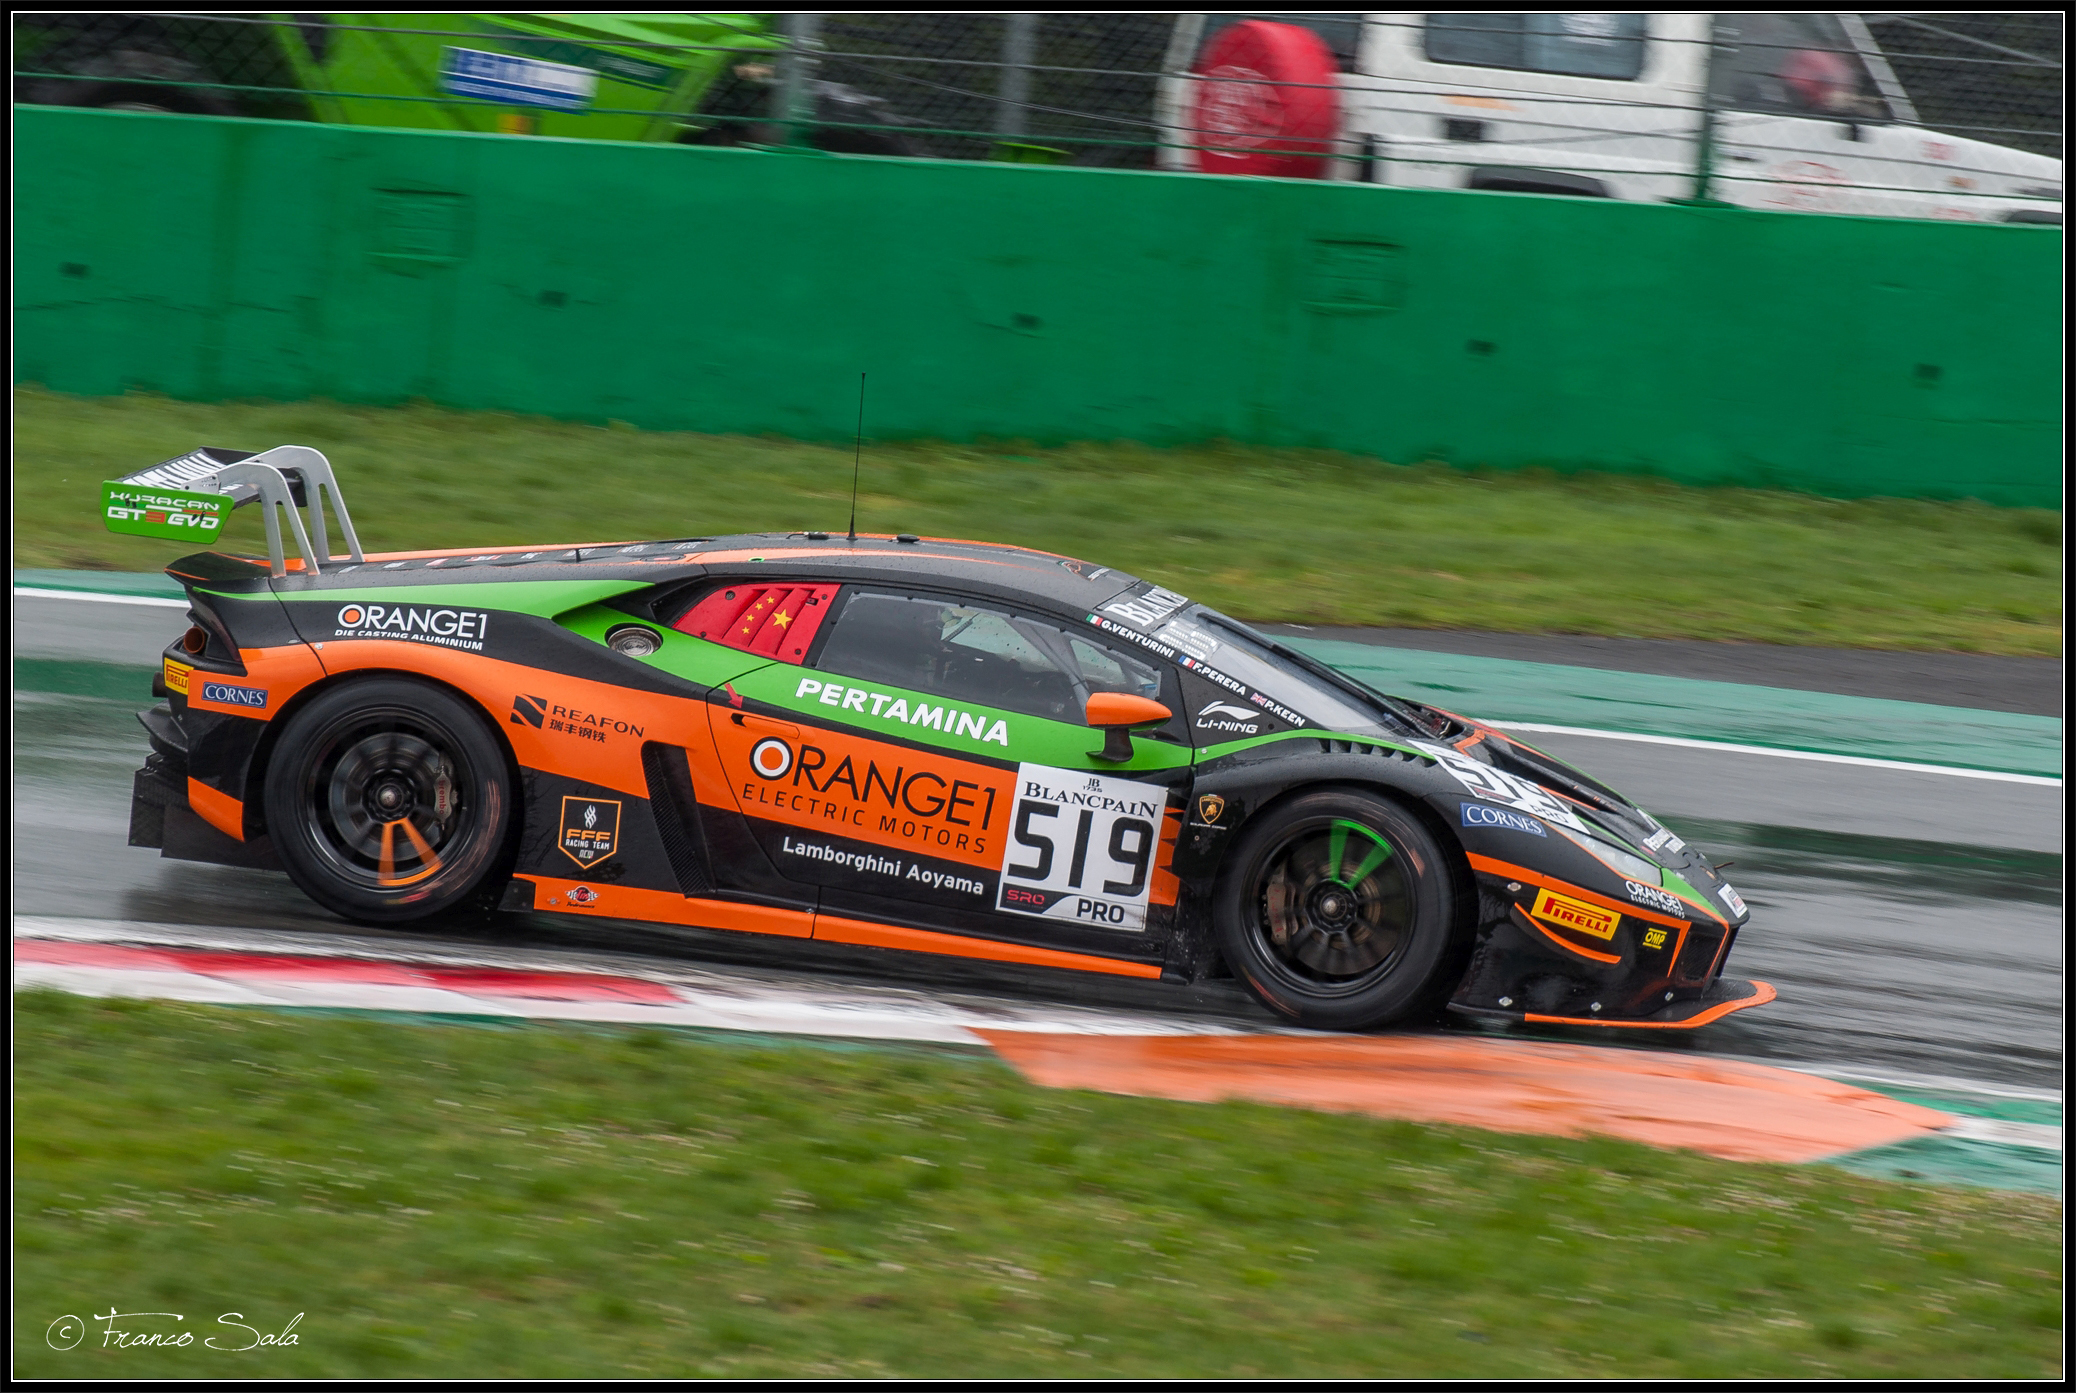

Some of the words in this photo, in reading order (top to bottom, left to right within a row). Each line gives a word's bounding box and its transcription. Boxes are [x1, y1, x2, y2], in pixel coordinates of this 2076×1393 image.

[110, 491, 219, 511] HURACAN
[107, 506, 166, 524] GT3
[167, 513, 219, 529] EVO
[338, 604, 487, 640] ORANGE1
[334, 629, 355, 637] DIE
[357, 630, 408, 639] CASTING
[411, 633, 483, 651] ALUMINIUM
[1101, 619, 1175, 659] G.VENTURINI
[1192, 662, 1247, 696] F.PERERA
[205, 685, 264, 706] CORNES
[552, 705, 645, 738] REAFON
[795, 678, 1008, 747] PERTAMINA
[1196, 718, 1258, 734] LI-NING
[1264, 699, 1305, 727] P.KEEN
[549, 719, 607, 743] 瑞丰钢铁
[439, 780, 447, 815] brembo
[749, 736, 996, 831] ORANGE1
[1023, 781, 1158, 819] BLANCPAIN
[742, 783, 865, 826] ELECTRIC
[879, 815, 987, 854] MOTORS
[1466, 806, 1542, 834] CORNES
[566, 828, 611, 842] FFF
[566, 839, 589, 848] RACING
[592, 841, 610, 850] TEAM
[1007, 799, 1154, 897] 519
[783, 836, 901, 877] Lamborghini
[906, 864, 984, 895] Aoyama
[1007, 889, 1045, 905] SRO
[1076, 898, 1124, 923] PRO
[1626, 881, 1683, 911] ORANGE1
[1542, 896, 1612, 933] PIRELLI
[1645, 931, 1665, 945] OMP
